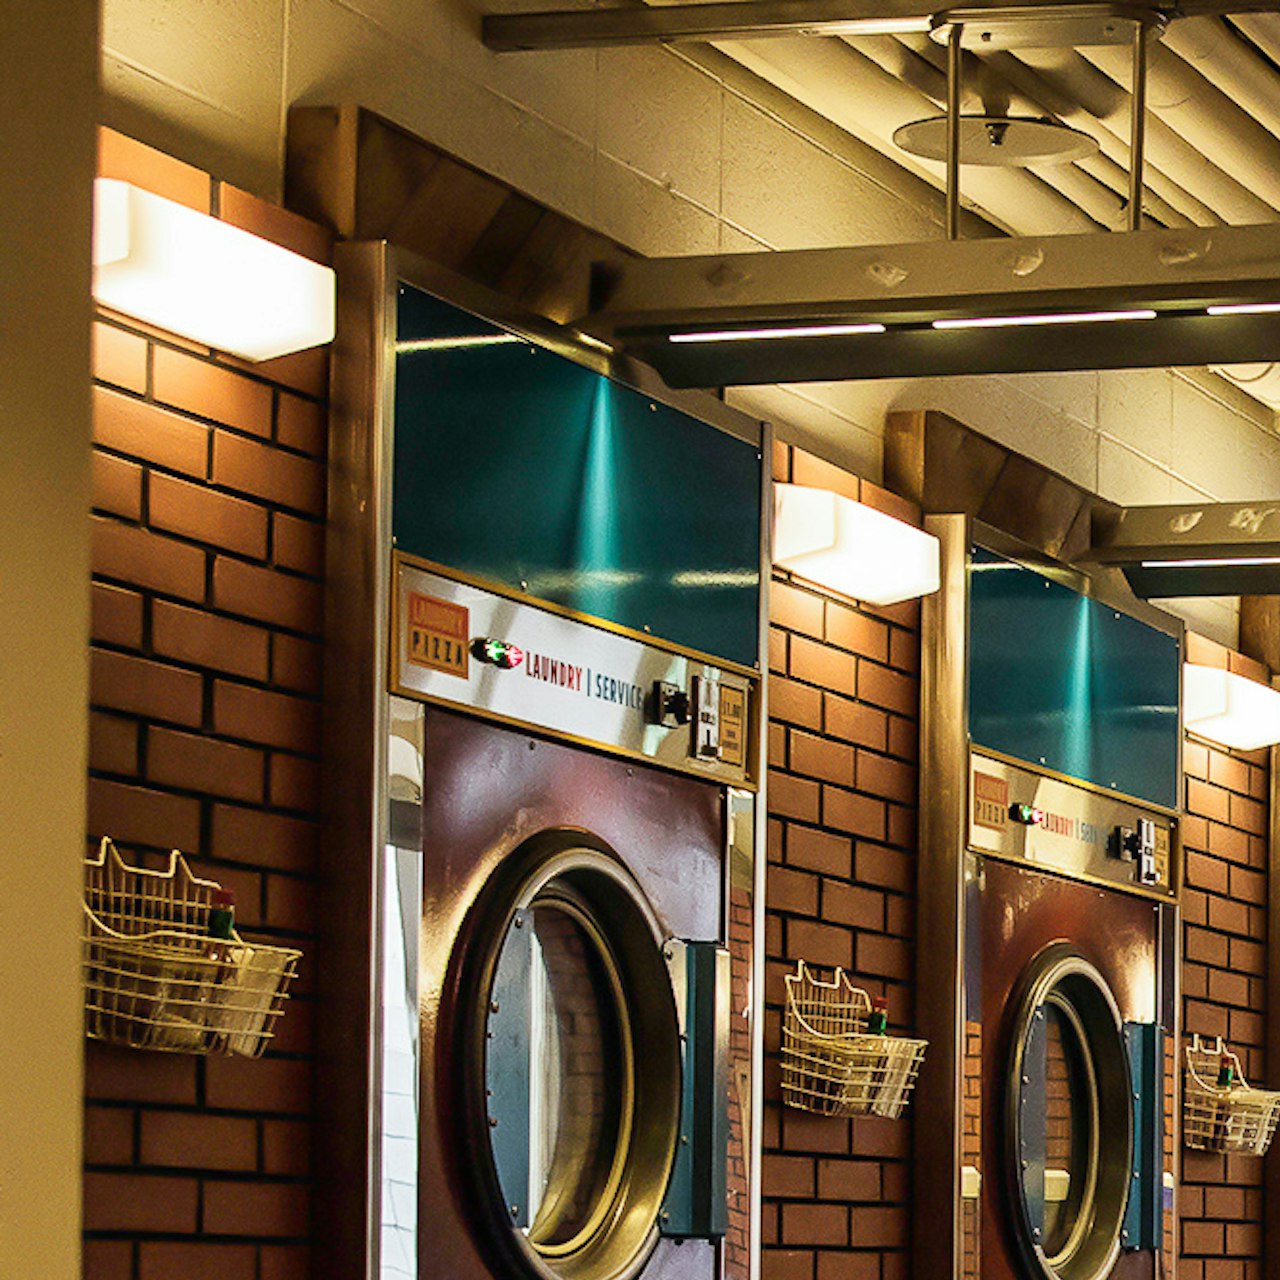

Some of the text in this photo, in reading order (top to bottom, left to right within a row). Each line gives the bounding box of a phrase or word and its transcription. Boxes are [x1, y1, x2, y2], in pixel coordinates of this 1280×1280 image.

[412, 631, 463, 668] PIZZA
[526, 651, 644, 712] LAUNDRY SERVICE
